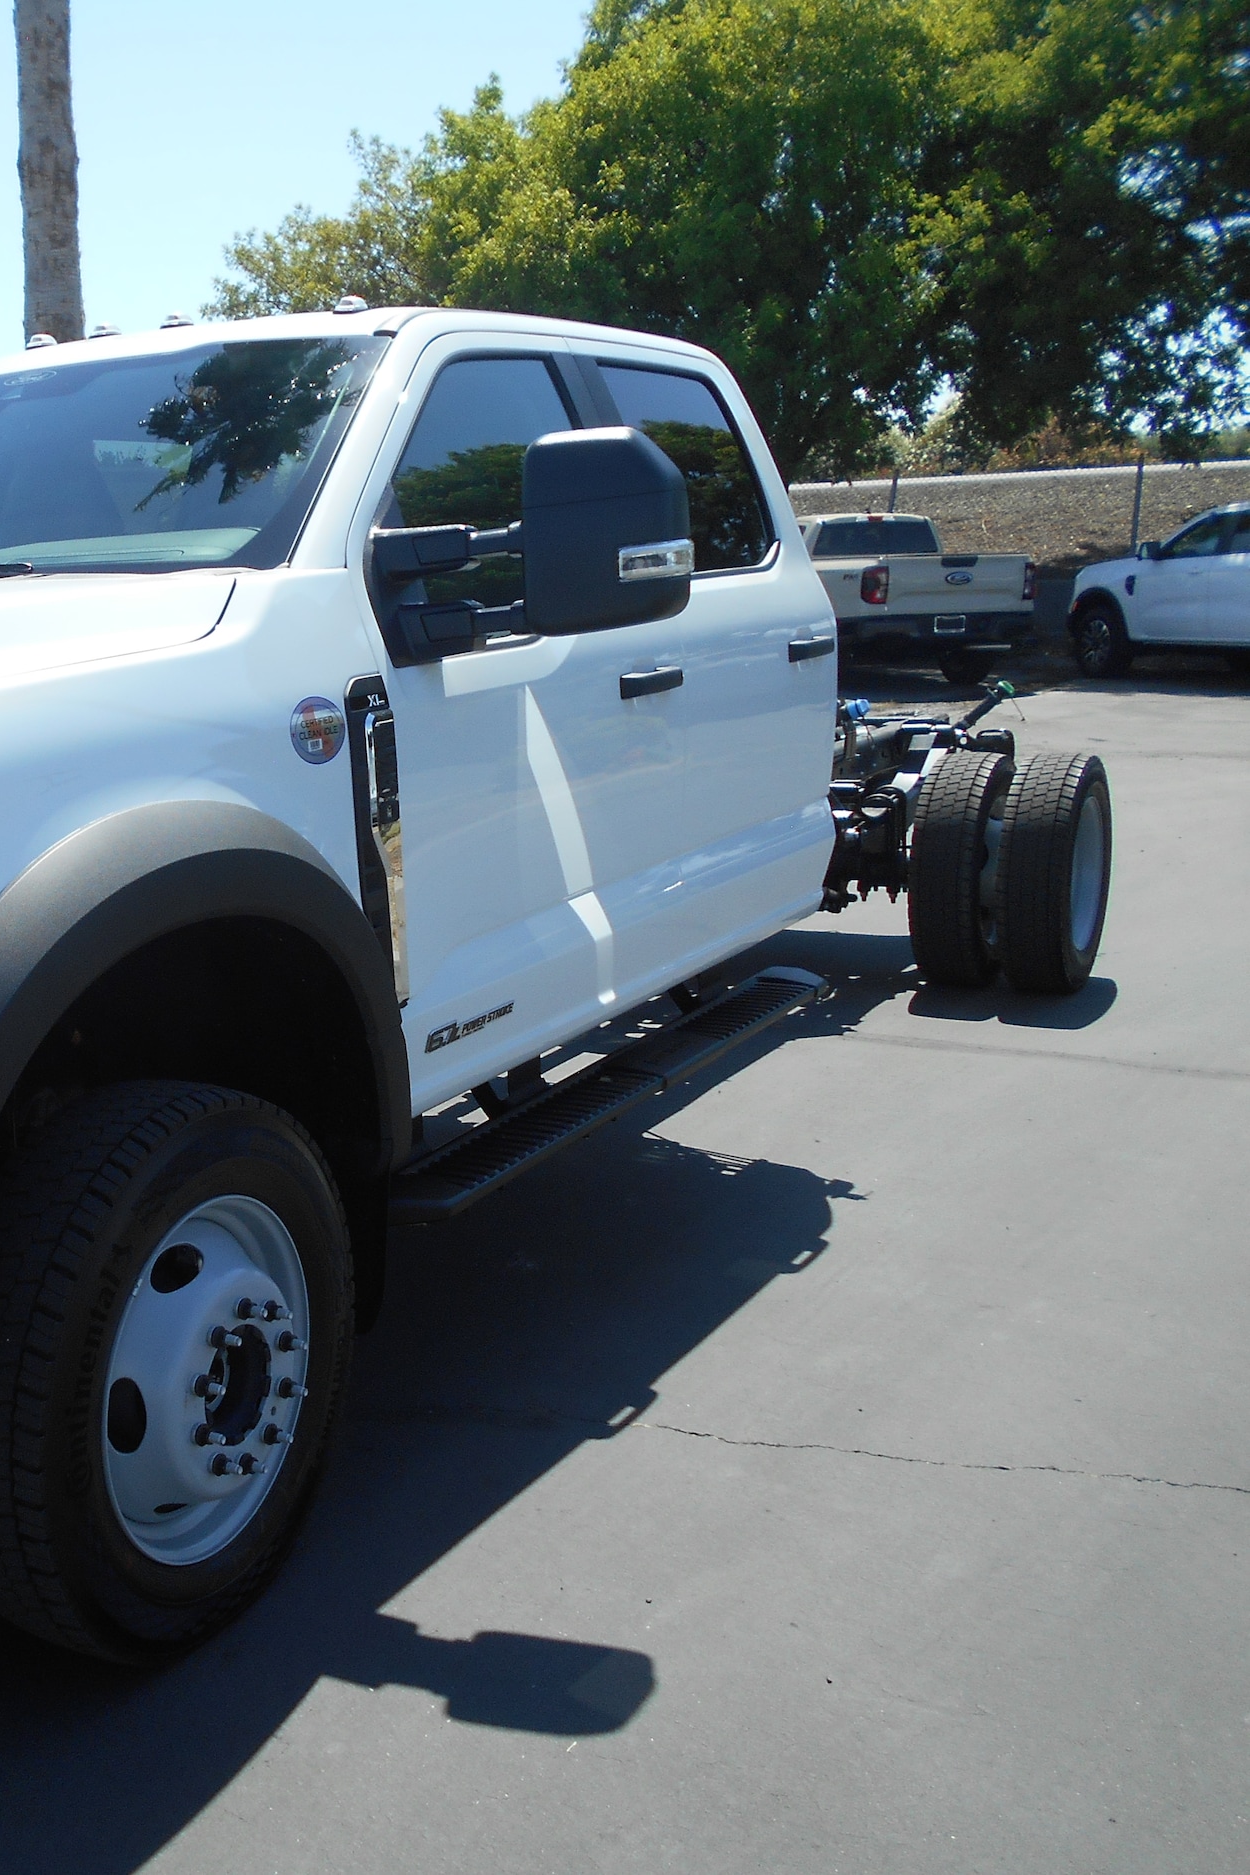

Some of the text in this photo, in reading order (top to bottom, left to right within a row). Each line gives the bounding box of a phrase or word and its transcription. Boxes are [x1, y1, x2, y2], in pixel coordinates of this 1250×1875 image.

[367, 694, 385, 707] XL
[300, 715, 334, 729] CERTIFIED
[298, 725, 339, 741] CLEAN IDLE
[461, 1015, 487, 1034] POWER
[486, 1002, 514, 1023] STROKE
